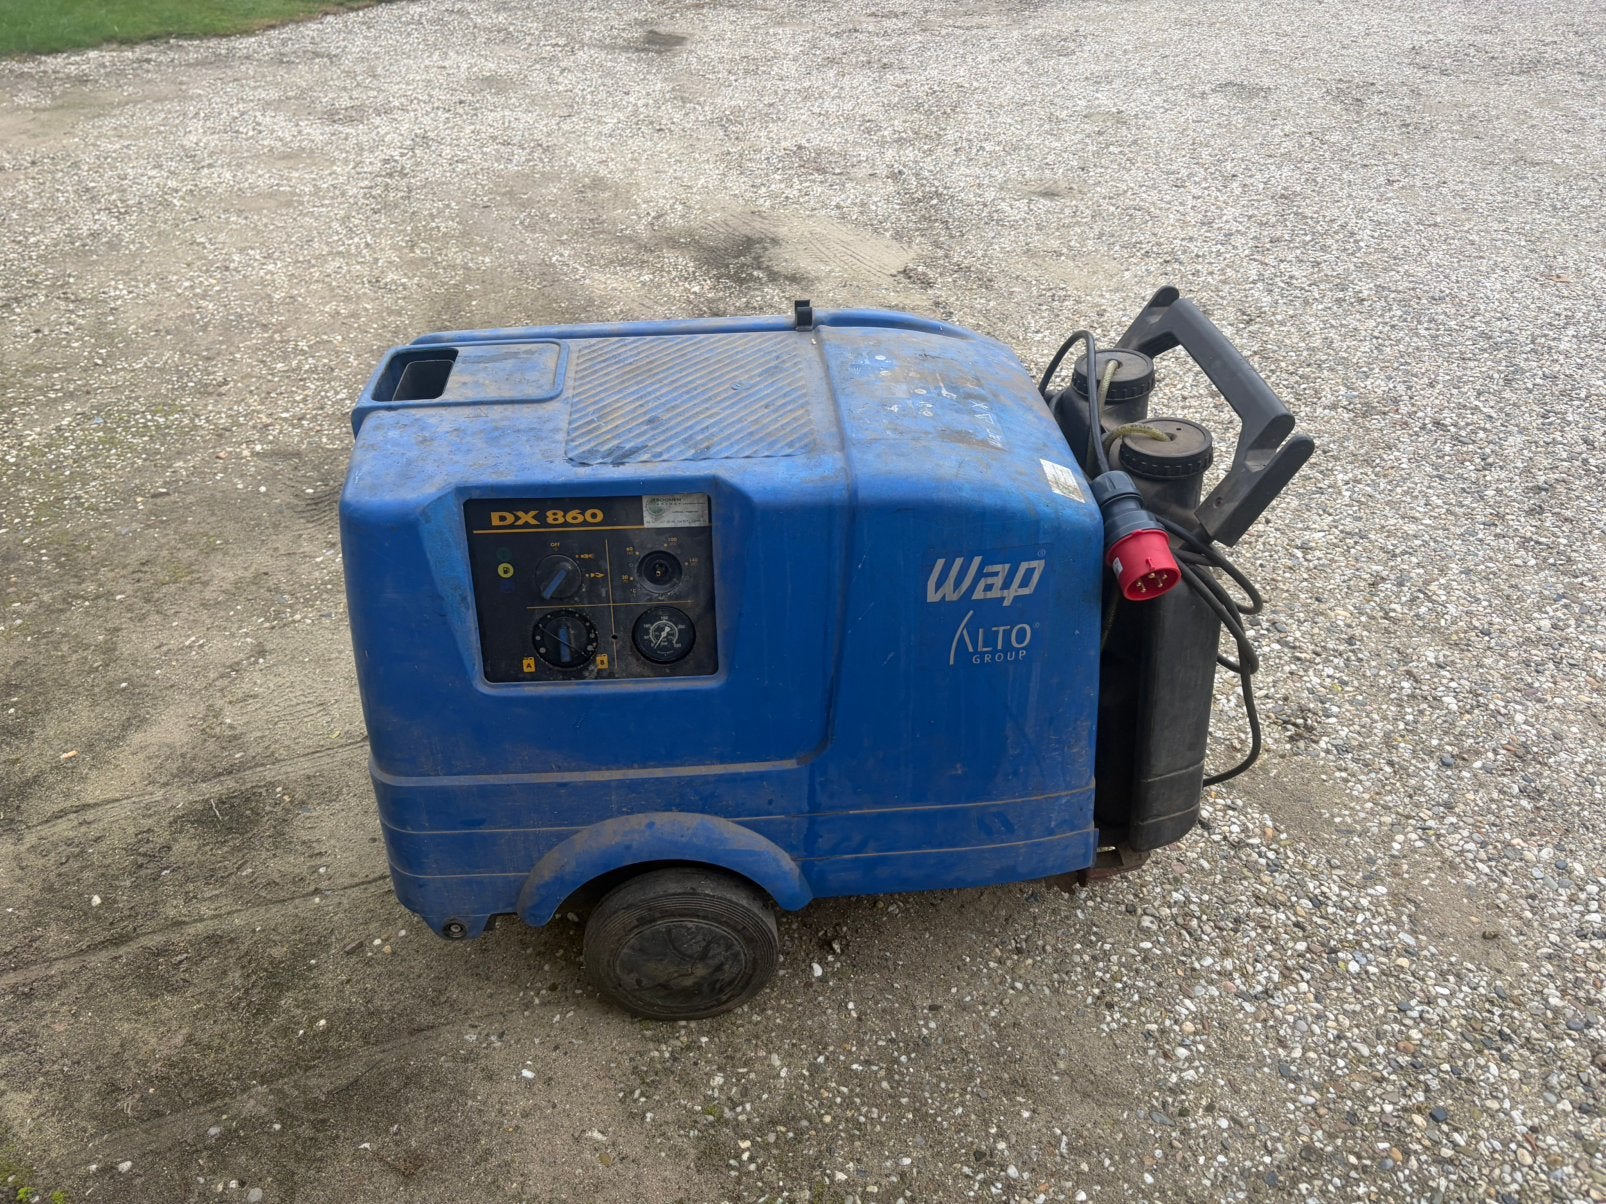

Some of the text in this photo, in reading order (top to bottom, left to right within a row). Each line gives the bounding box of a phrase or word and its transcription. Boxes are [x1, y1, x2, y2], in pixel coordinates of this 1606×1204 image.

[490, 508, 604, 526] DX 860
[926, 555, 1046, 607] Wap
[949, 609, 1032, 665] ALTO
[972, 649, 1027, 664] GROUP
